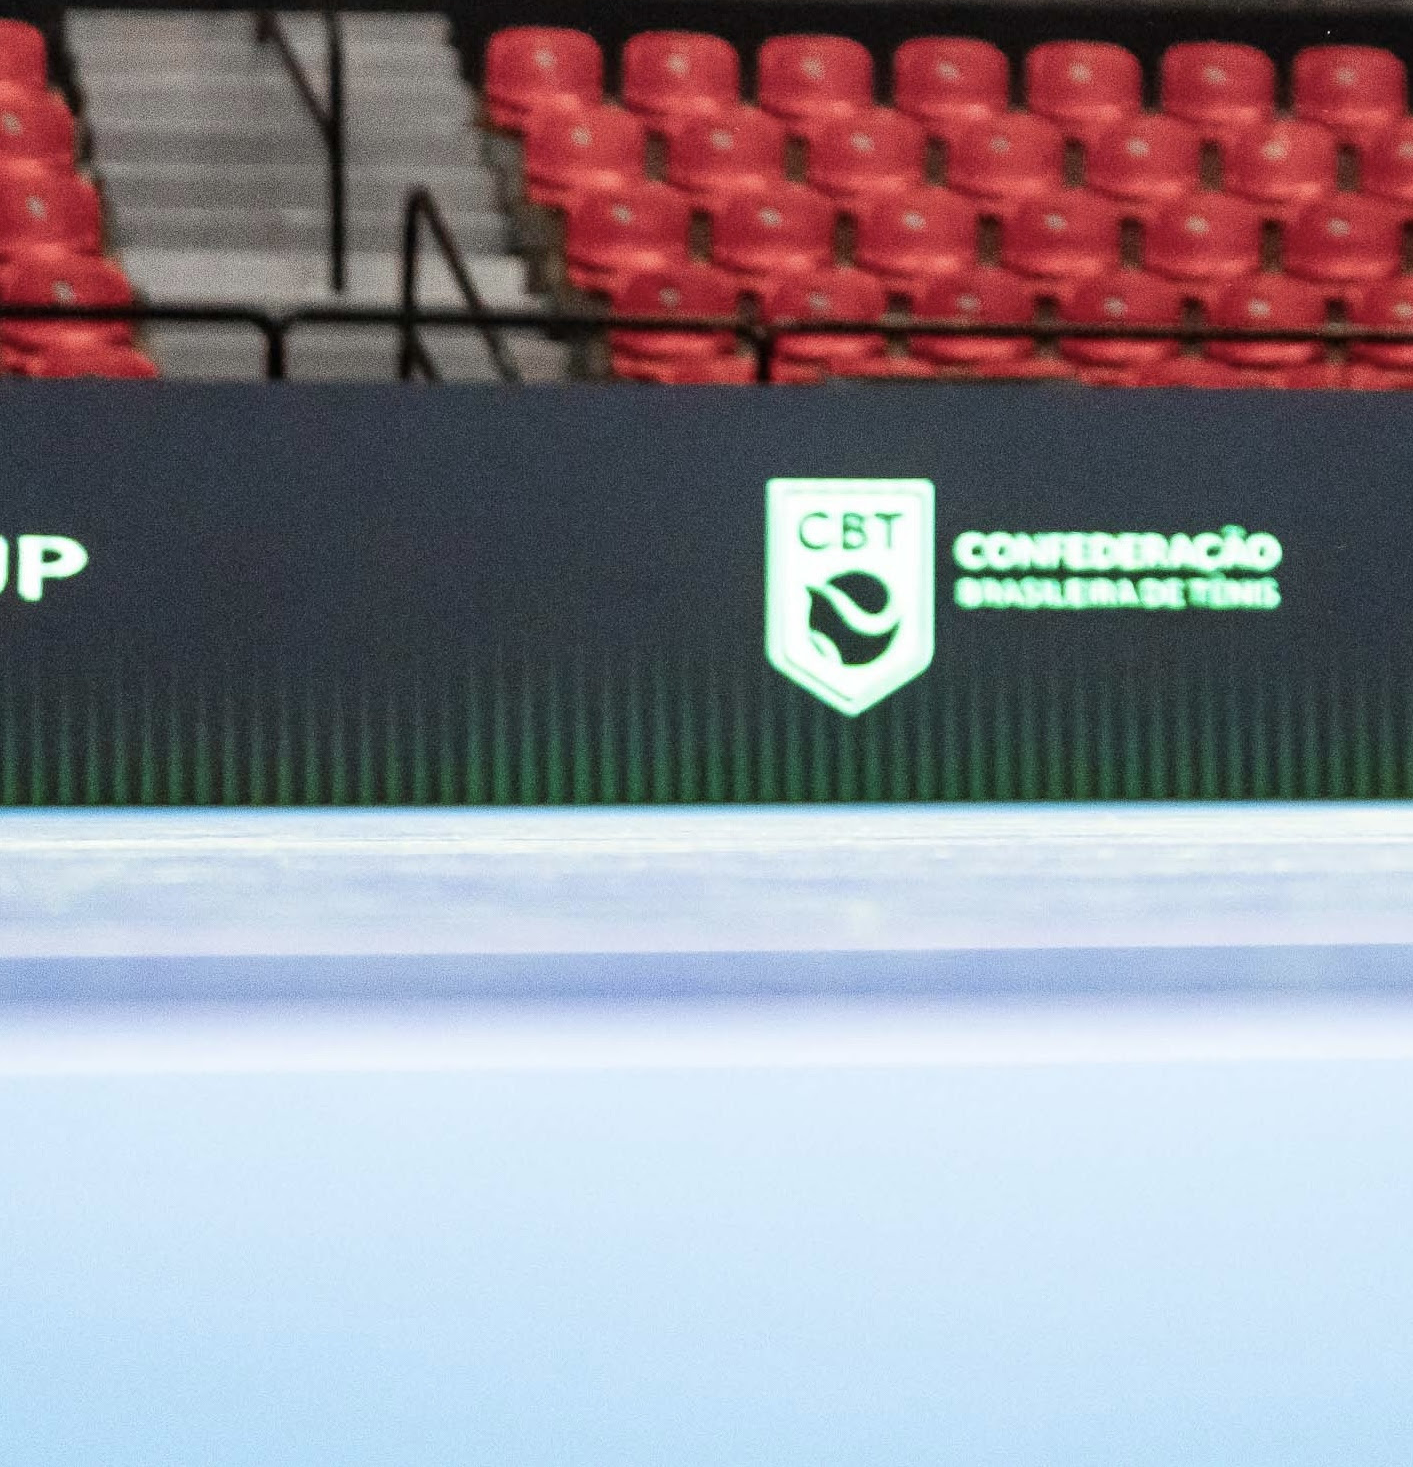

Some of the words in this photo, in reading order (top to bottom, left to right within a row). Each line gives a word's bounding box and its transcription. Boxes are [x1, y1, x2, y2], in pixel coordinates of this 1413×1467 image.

[799, 511, 903, 550] CBT
[952, 524, 1284, 573] CONFEDERAÇÃO
[0, 534, 89, 602] P
